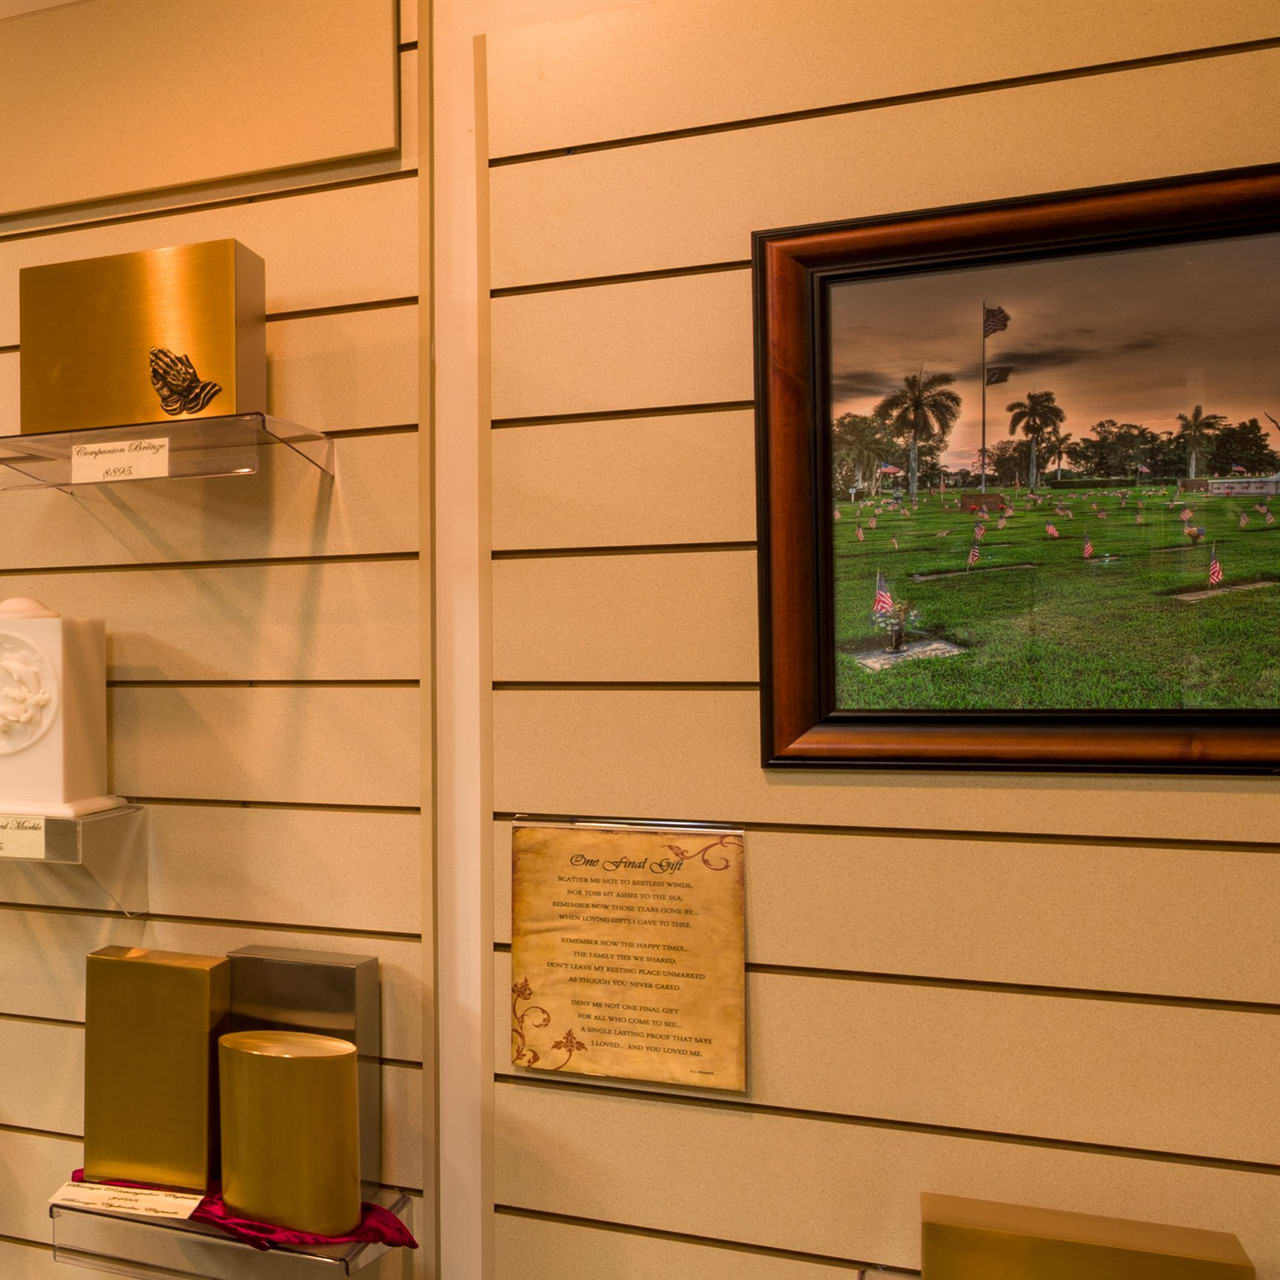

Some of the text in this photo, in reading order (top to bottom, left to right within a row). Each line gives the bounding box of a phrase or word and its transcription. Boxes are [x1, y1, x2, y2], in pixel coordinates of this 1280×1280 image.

[74, 441, 166, 460] Companion Bronze
[9, 819, 43, 831] Marble
[570, 854, 684, 876] One Final Gift
[557, 876, 589, 884] SCATTER
[632, 879, 665, 887] RESTLESS
[615, 891, 638, 899] ASHES
[652, 893, 666, 901] THE
[552, 901, 590, 909] REMEMBER
[591, 902, 609, 910] NOW
[611, 904, 635, 912] THOSE
[660, 907, 682, 915] GONE
[582, 915, 610, 924] LOVING
[611, 916, 633, 925] GIFTS
[637, 918, 658, 926] GAVE
[561, 937, 599, 945] REMEMBER
[620, 940, 635, 948] THE
[636, 942, 660, 951] HAPPY
[573, 950, 588, 958] THE
[589, 951, 615, 960] FAMILY
[617, 953, 632, 961] TIES
[546, 961, 569, 969] DON'T
[570, 963, 592, 971] LEAVE
[606, 965, 637, 975] RESTING
[638, 968, 661, 977] PLACE
[662, 970, 706, 980] UNMARKED
[579, 977, 611, 985] THOUGH
[612, 979, 629, 987] YOU
[629, 980, 653, 989] NEVER
[571, 999, 591, 1007] DENY
[604, 1002, 620, 1010] NOT
[638, 1005, 661, 1014] FINAL
[662, 1007, 680, 1015] GIFT
[594, 1014, 607, 1022] ALL
[608, 1015, 627, 1024] WHO
[628, 1017, 651, 1025] COME
[587, 1027, 612, 1035] SINGLE
[614, 1030, 645, 1038] LASTING
[646, 1032, 672, 1041] PROOF
[673, 1035, 693, 1043] THAT
[694, 1037, 712, 1045] SAYS
[645, 1045, 662, 1053] YOU
[663, 1047, 688, 1056] LOVED
